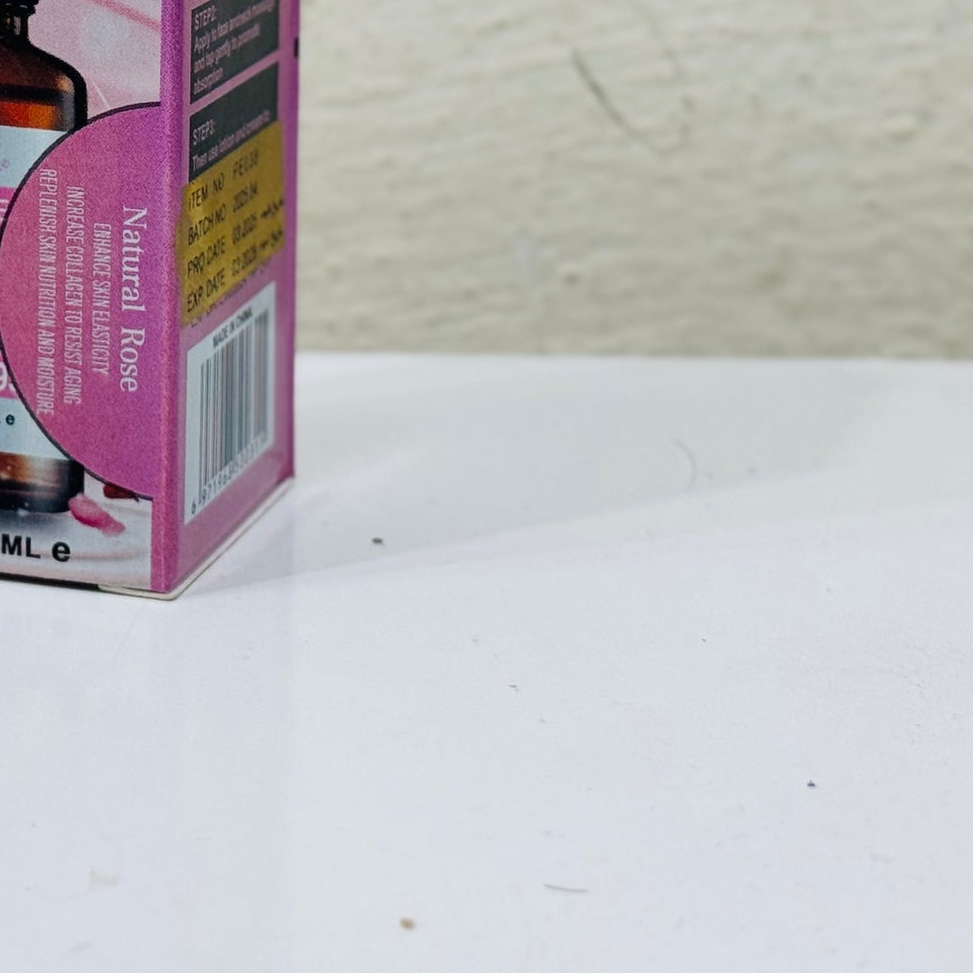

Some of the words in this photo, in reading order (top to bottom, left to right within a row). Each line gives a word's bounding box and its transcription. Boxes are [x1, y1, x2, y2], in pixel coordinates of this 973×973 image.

[39, 169, 57, 233] REPLENISH
[66, 186, 84, 244] INCREASE
[188, 186, 208, 211] ITEM
[188, 216, 213, 246] BATCH
[214, 203, 226, 224] NO
[39, 234, 56, 263] SKIN
[93, 222, 112, 278] ENHANCE
[121, 206, 148, 312] Natural
[187, 253, 204, 279] PRO
[206, 235, 226, 265] DATE
[38, 265, 56, 327] NUTRITION
[65, 246, 84, 307] COLLAGEN
[92, 279, 111, 308] SKIN
[186, 285, 203, 313] EXP
[206, 267, 225, 298] DATE
[64, 310, 82, 324] TO
[37, 328, 55, 354] AND
[64, 326, 82, 365] RESIST
[91, 310, 110, 375] ELASTICITY
[120, 327, 146, 392] Rose
[36, 356, 55, 415] MOISTURE
[63, 366, 82, 405] AGING
[51, 541, 71, 563] e
